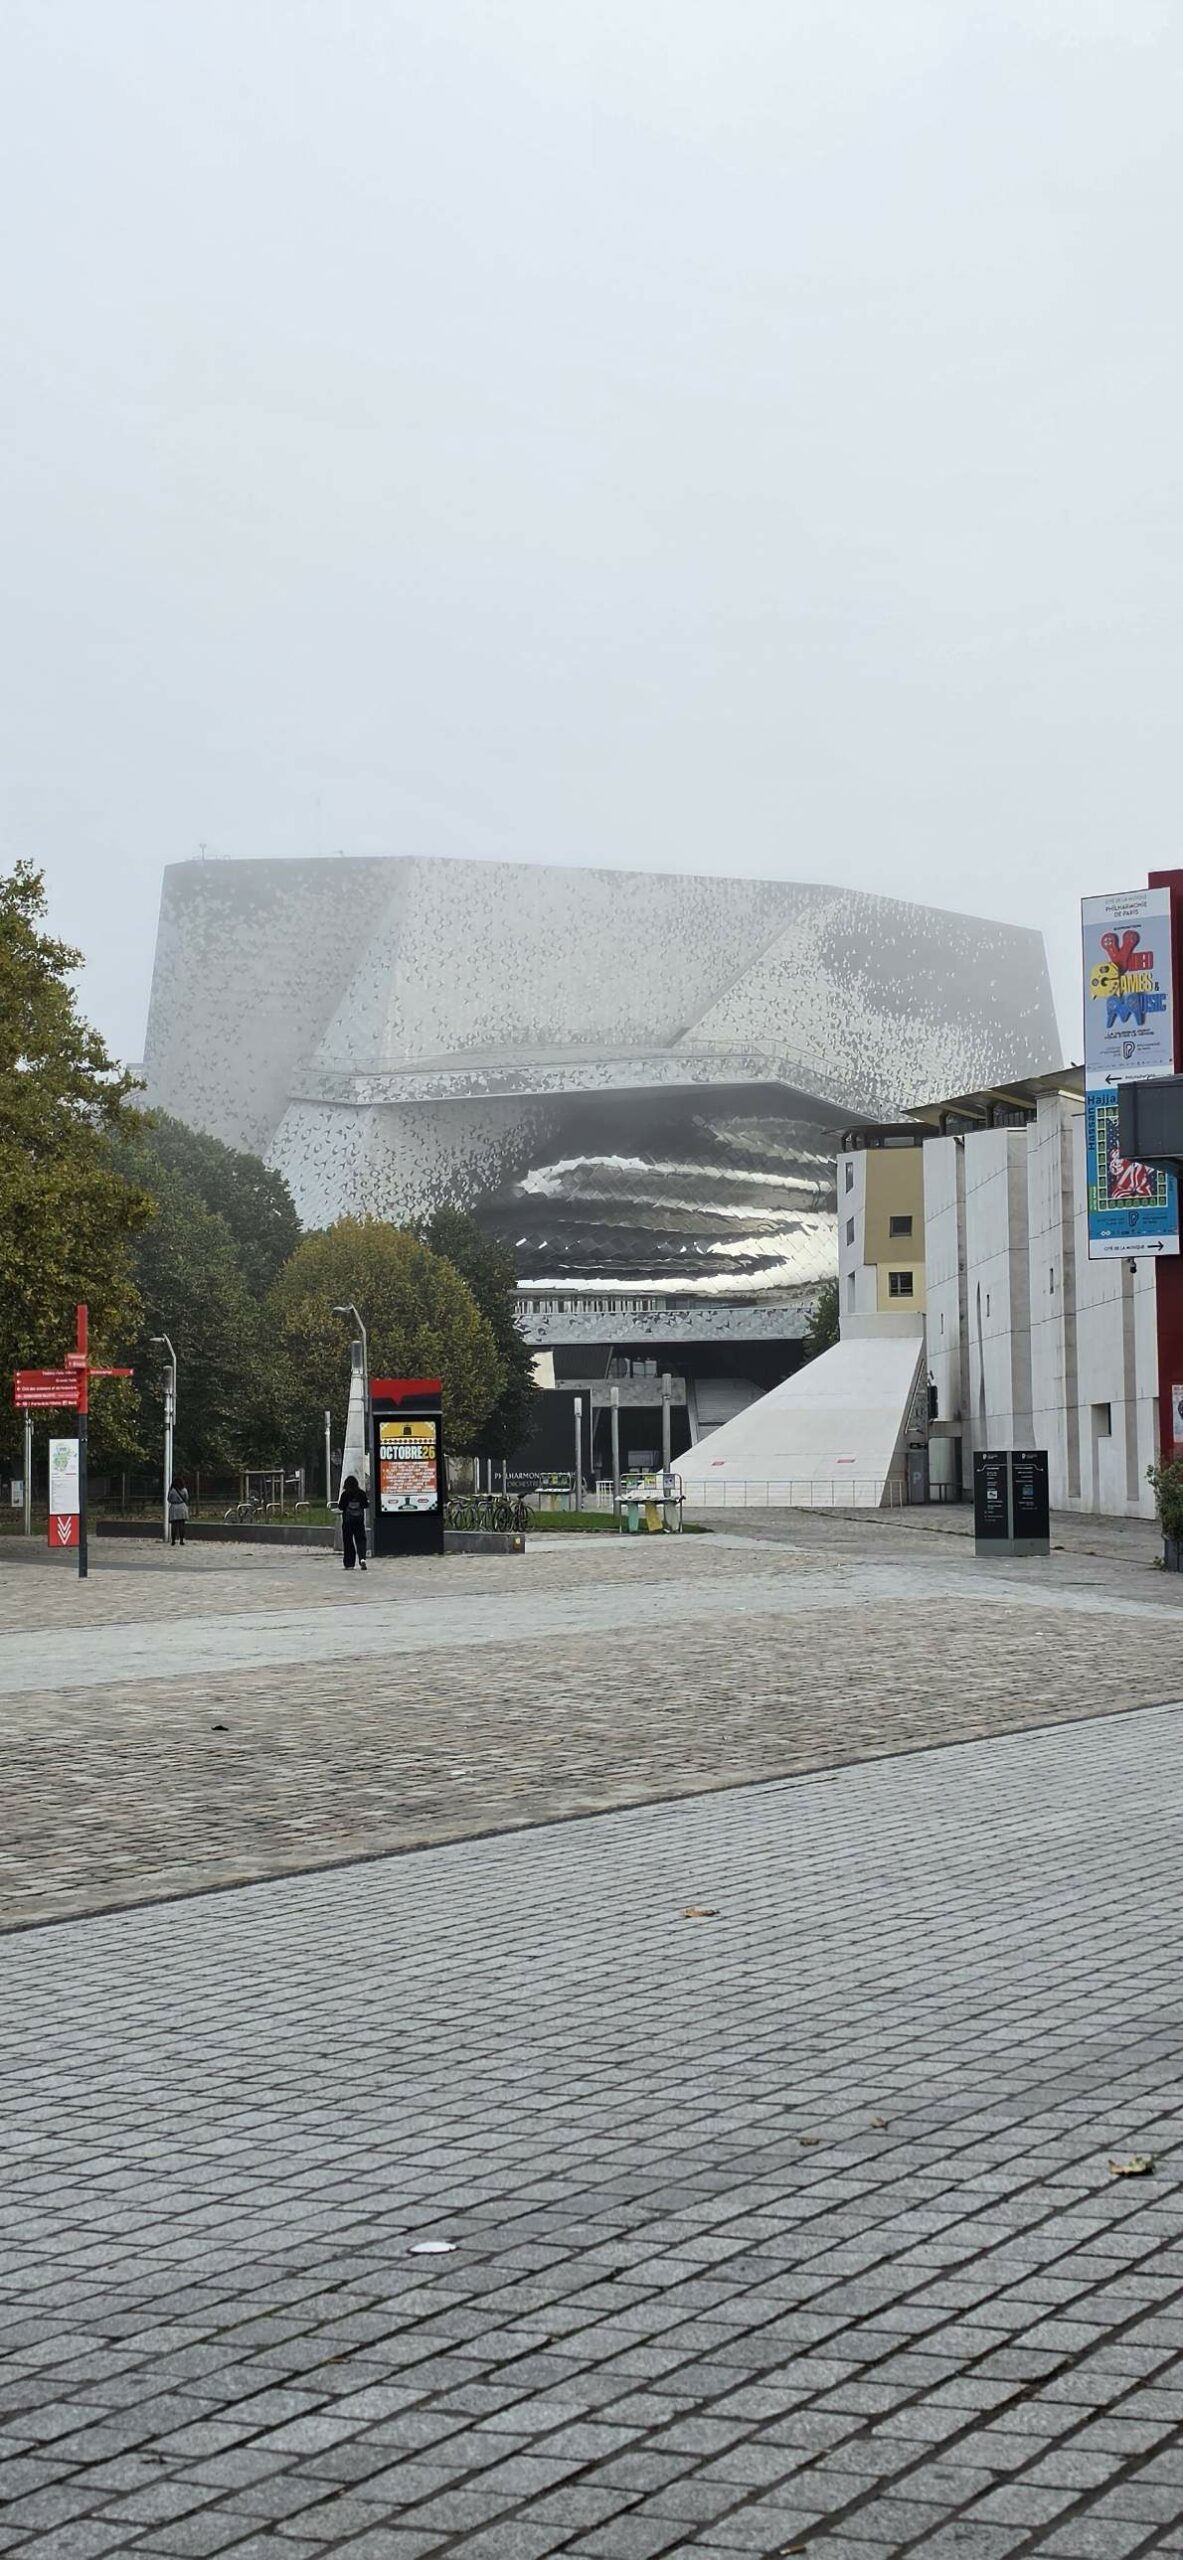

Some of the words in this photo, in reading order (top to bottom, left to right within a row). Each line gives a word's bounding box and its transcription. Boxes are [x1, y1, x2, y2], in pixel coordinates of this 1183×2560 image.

[1105, 901, 1147, 912] PHILHARMONIE
[1106, 993, 1167, 1028] MUSIC
[1088, 1094, 1116, 1106] Hajja
[1088, 1107, 1096, 1150] Hassan
